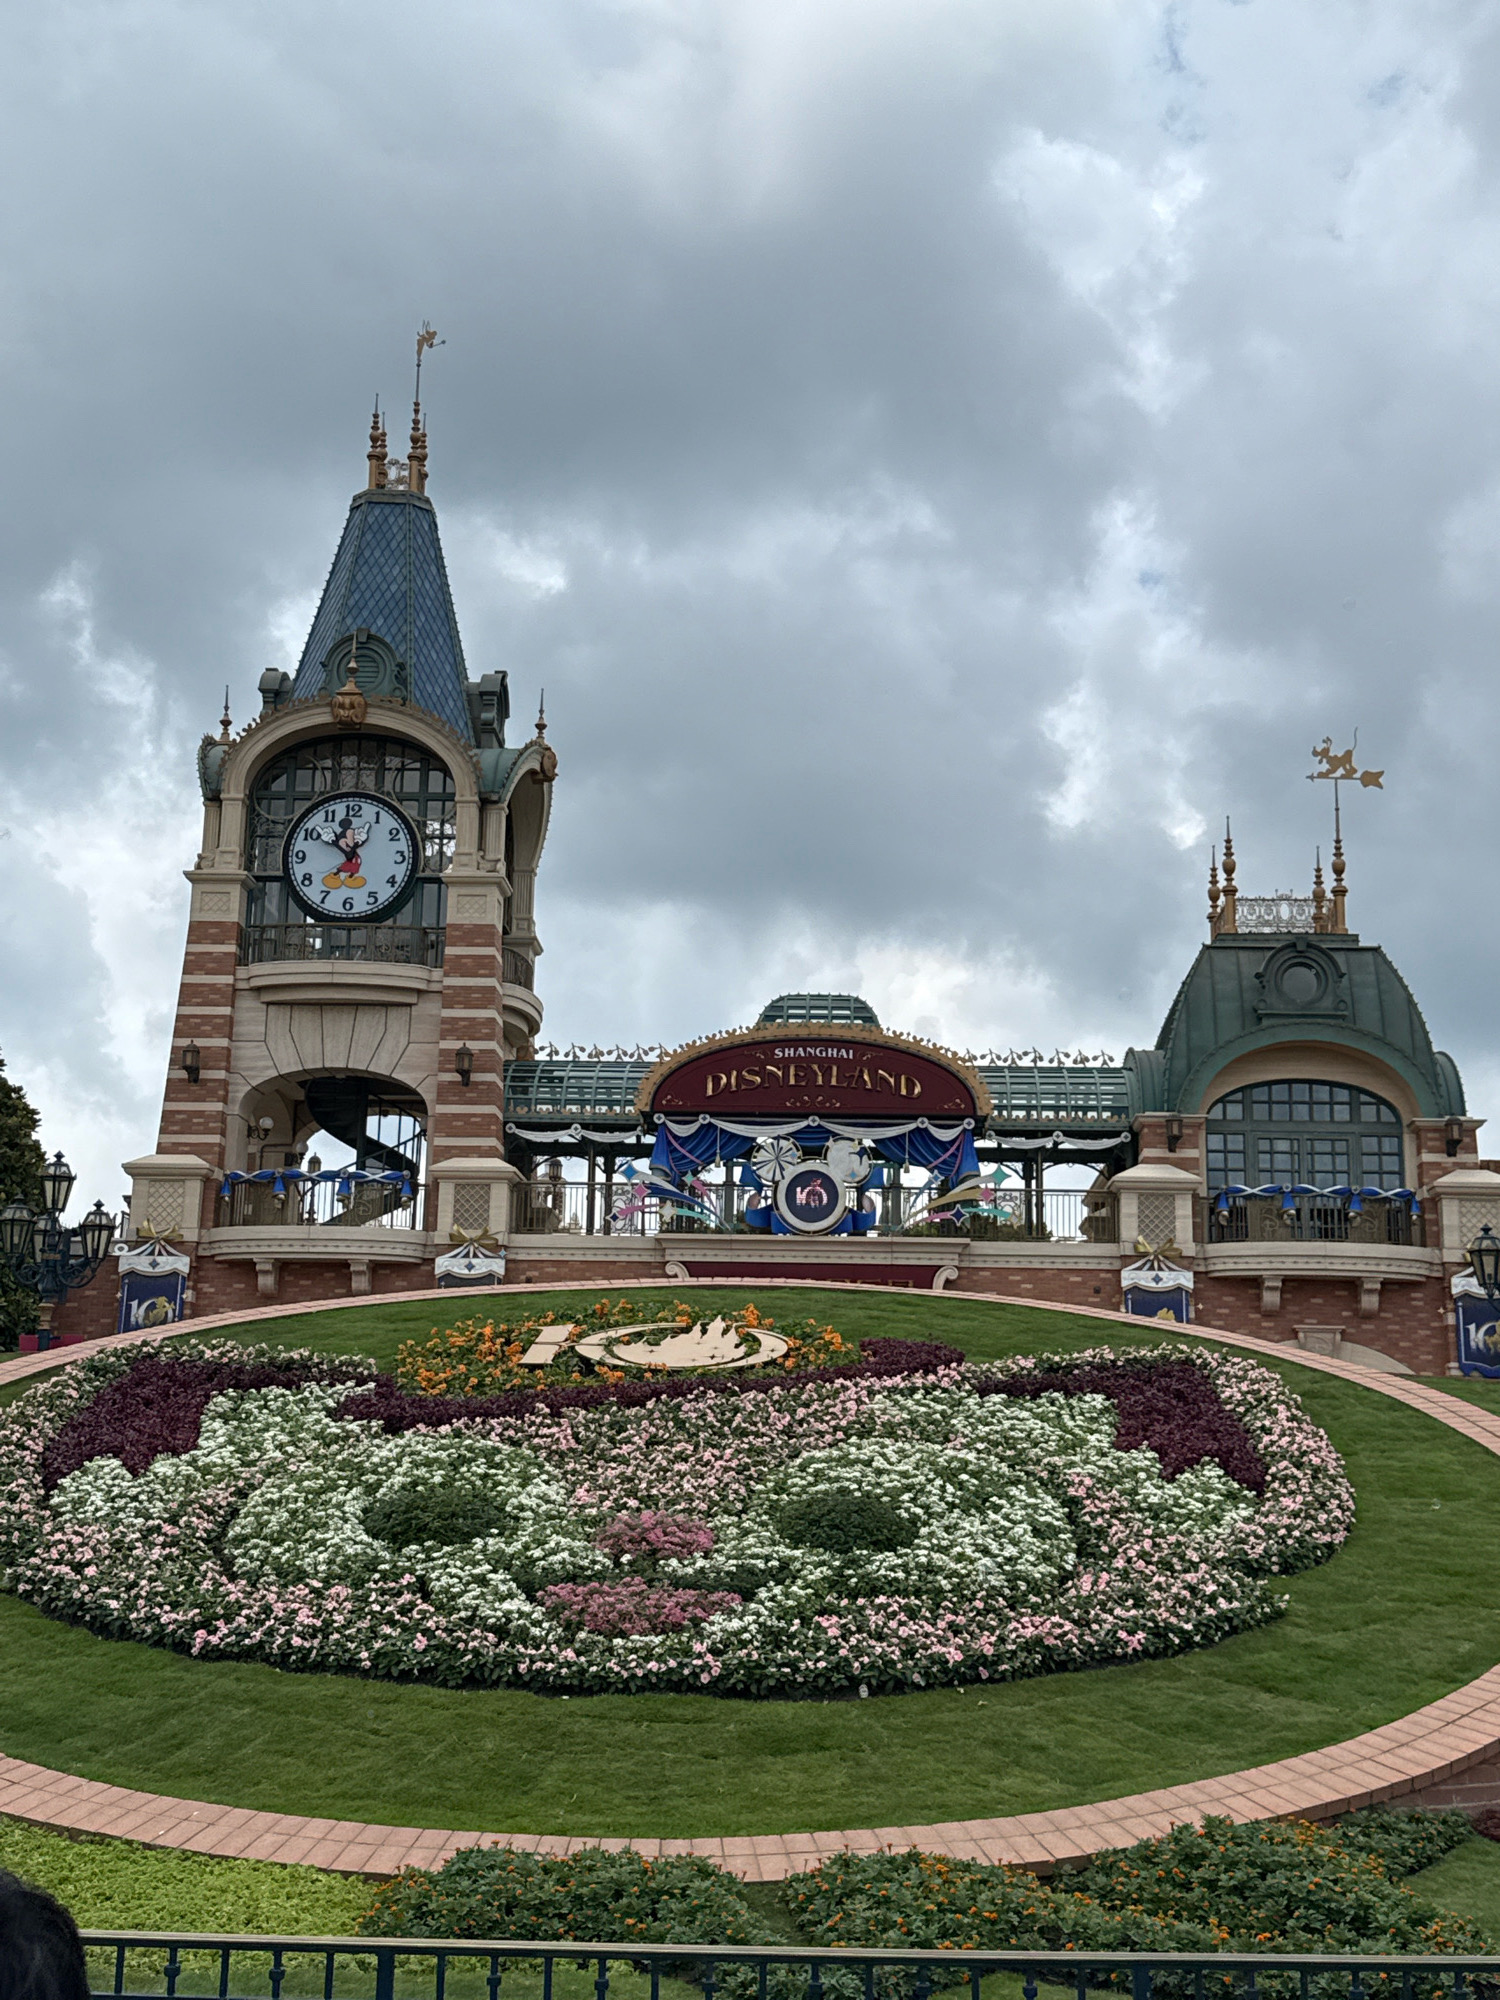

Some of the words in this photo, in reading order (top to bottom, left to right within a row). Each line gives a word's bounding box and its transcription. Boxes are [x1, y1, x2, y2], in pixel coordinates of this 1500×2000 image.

[323, 809, 336, 823] 11
[345, 804, 362, 818] 12
[374, 811, 381, 824] 1
[303, 827, 321, 841] 10
[389, 828, 400, 841] 2
[295, 850, 306, 864] 9
[394, 851, 406, 864] 3
[301, 873, 313, 887] 8
[386, 874, 398, 888] 4
[320, 890, 331, 905] 7
[342, 897, 354, 911] 6
[366, 891, 379, 905] 5
[773, 1047, 854, 1060] SHANGHAI
[705, 1063, 923, 1099] DISNEYLAND
